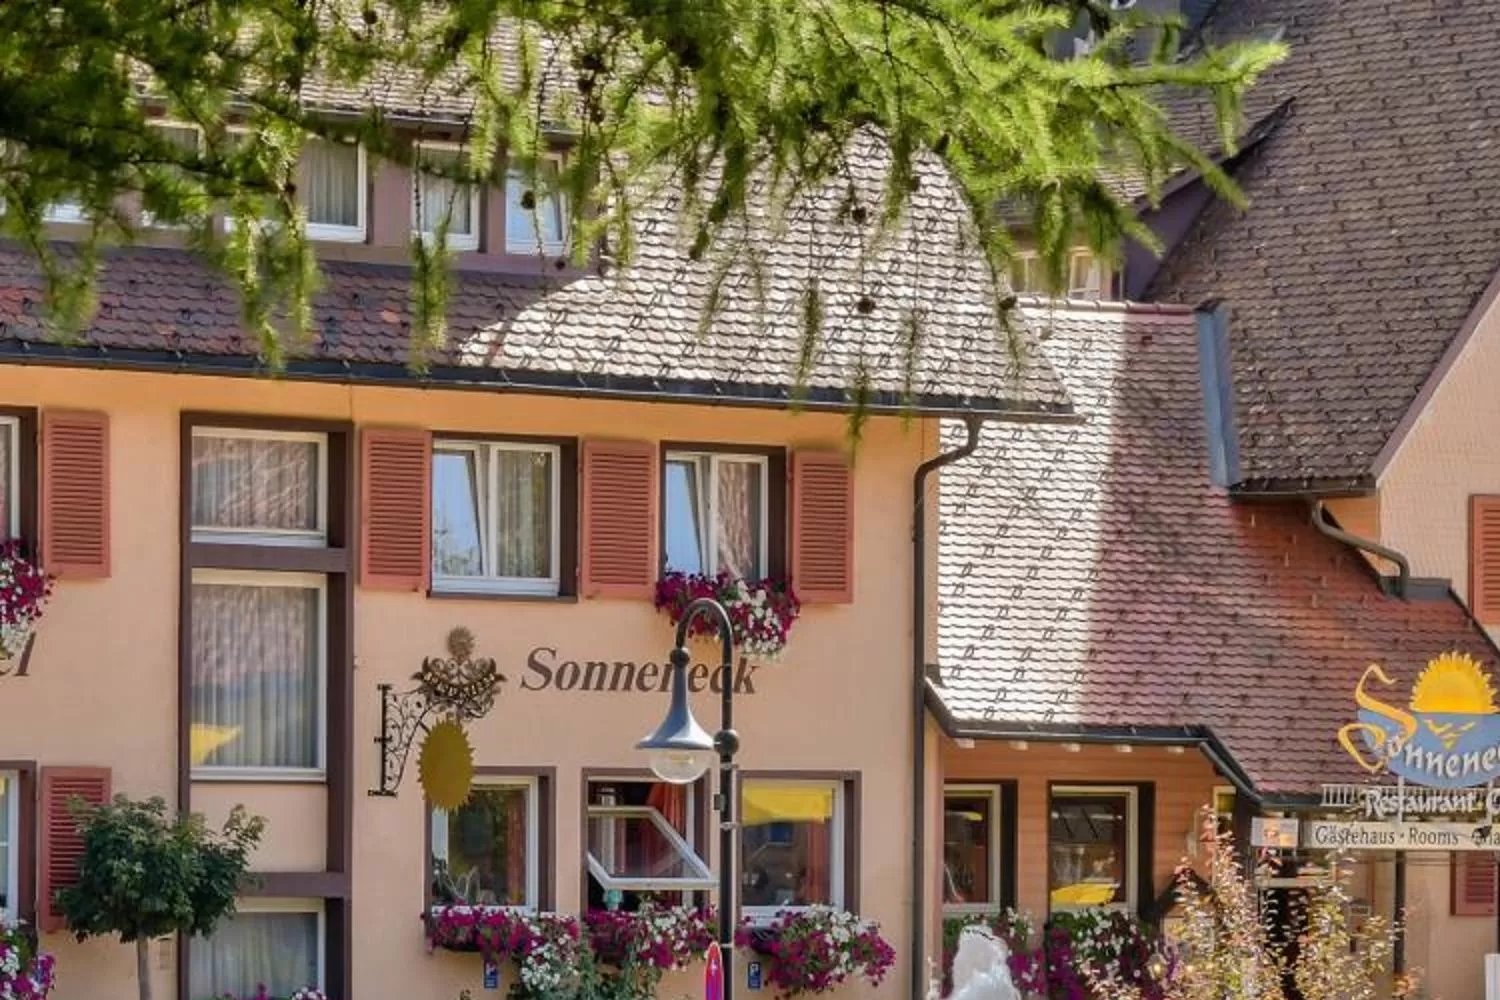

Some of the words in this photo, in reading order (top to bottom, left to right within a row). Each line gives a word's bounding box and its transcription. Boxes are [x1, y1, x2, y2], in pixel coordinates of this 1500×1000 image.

[1362, 787, 1477, 817] Restaurant
[1315, 824, 1396, 845] Gästehaus
[1408, 826, 1459, 845] Rooms
